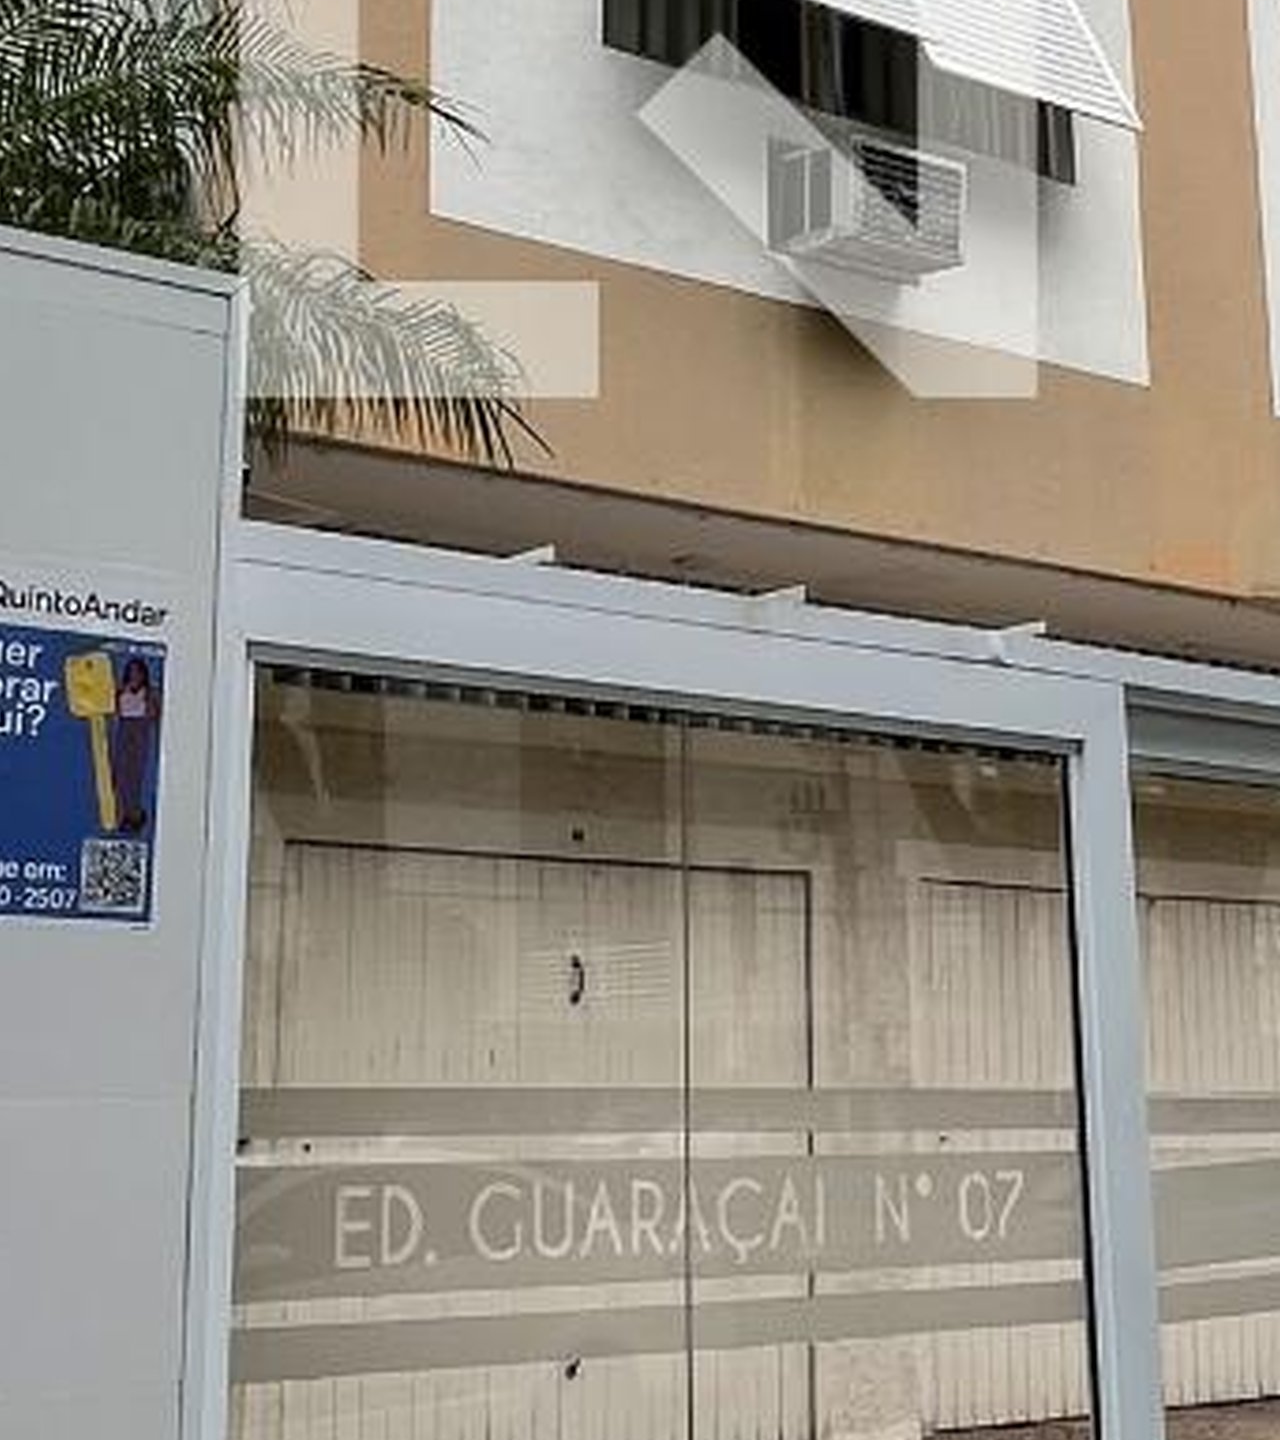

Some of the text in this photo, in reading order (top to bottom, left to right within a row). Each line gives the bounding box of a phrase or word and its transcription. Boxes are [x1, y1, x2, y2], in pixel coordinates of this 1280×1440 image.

[23, 860, 68, 882] em:
[334, 1183, 438, 1269] ED.
[469, 1175, 825, 1264] GUARAÇAI
[958, 1169, 1024, 1240] 07
